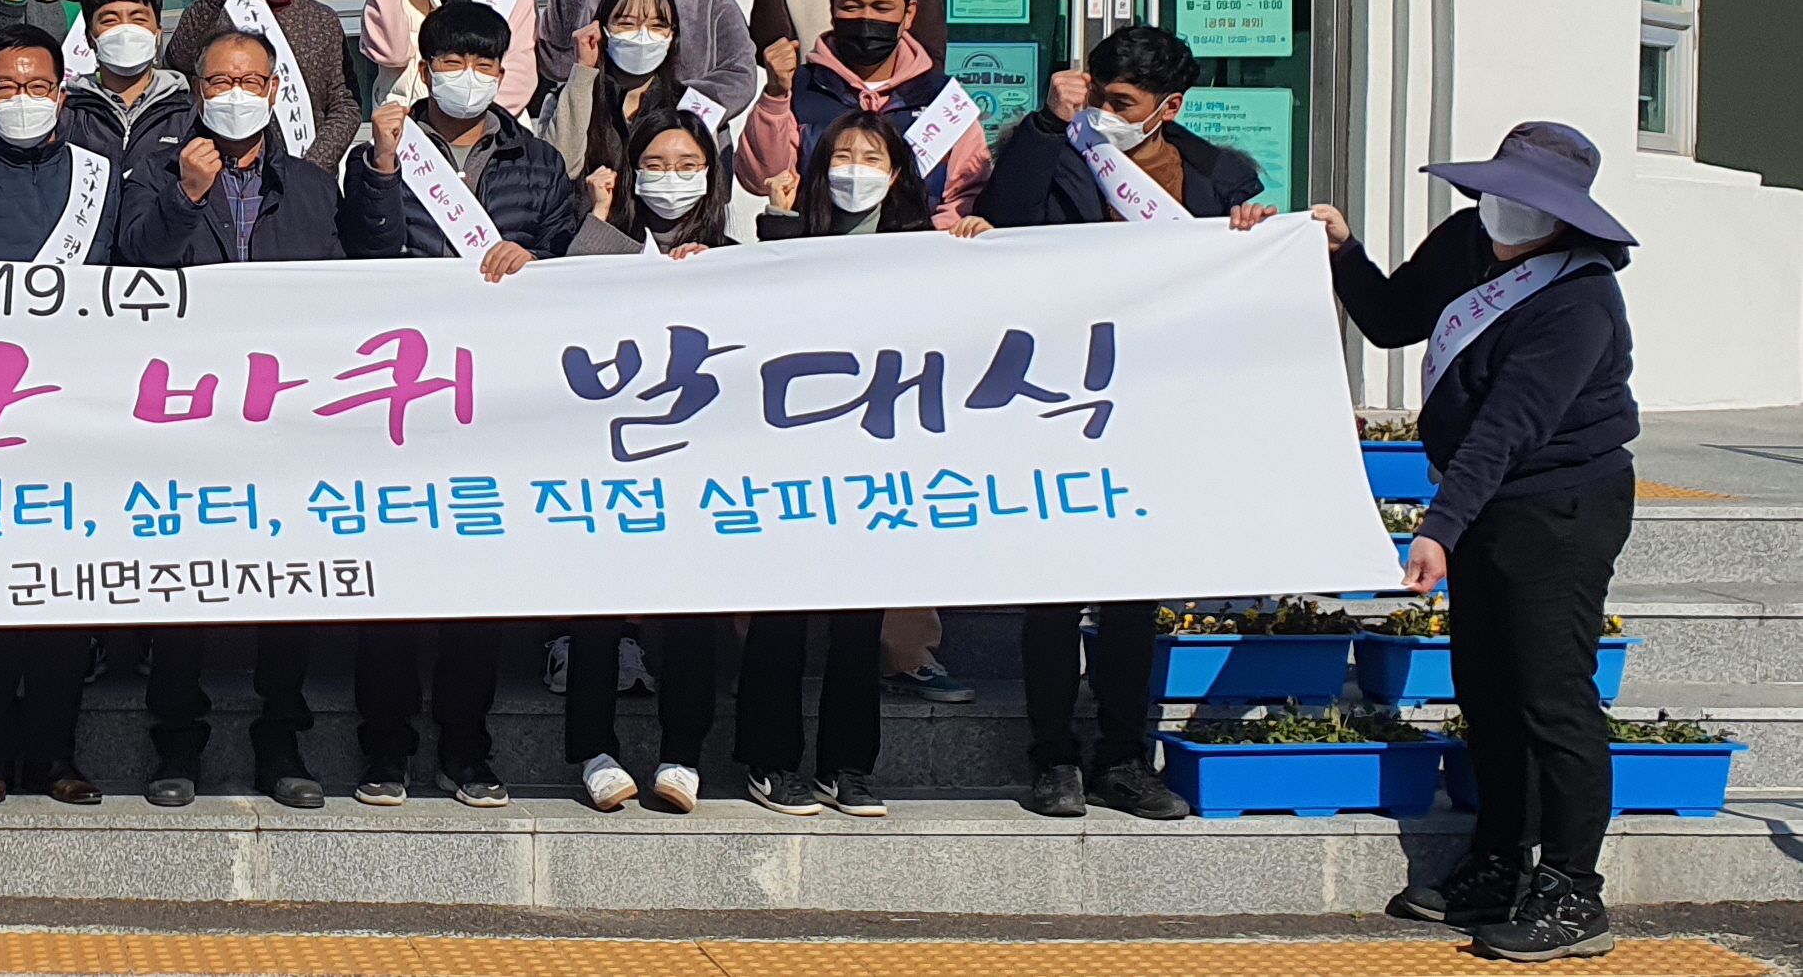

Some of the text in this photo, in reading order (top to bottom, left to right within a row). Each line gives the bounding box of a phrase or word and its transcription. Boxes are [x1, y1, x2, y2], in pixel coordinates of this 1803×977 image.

[75, 157, 103, 228] 찾아가는
[429, 183, 465, 222] 동네
[463, 224, 491, 249] 한
[1116, 182, 1159, 220] 동네
[133, 328, 473, 446] 바퀴
[562, 322, 1115, 462] 발대식
[124, 480, 281, 537] 삶터,
[307, 477, 505, 535] 쉼터를
[530, 478, 666, 533] 직접
[700, 468, 1147, 535] 살피겠습니다.
[8, 559, 374, 606] 군내면주민자치회
